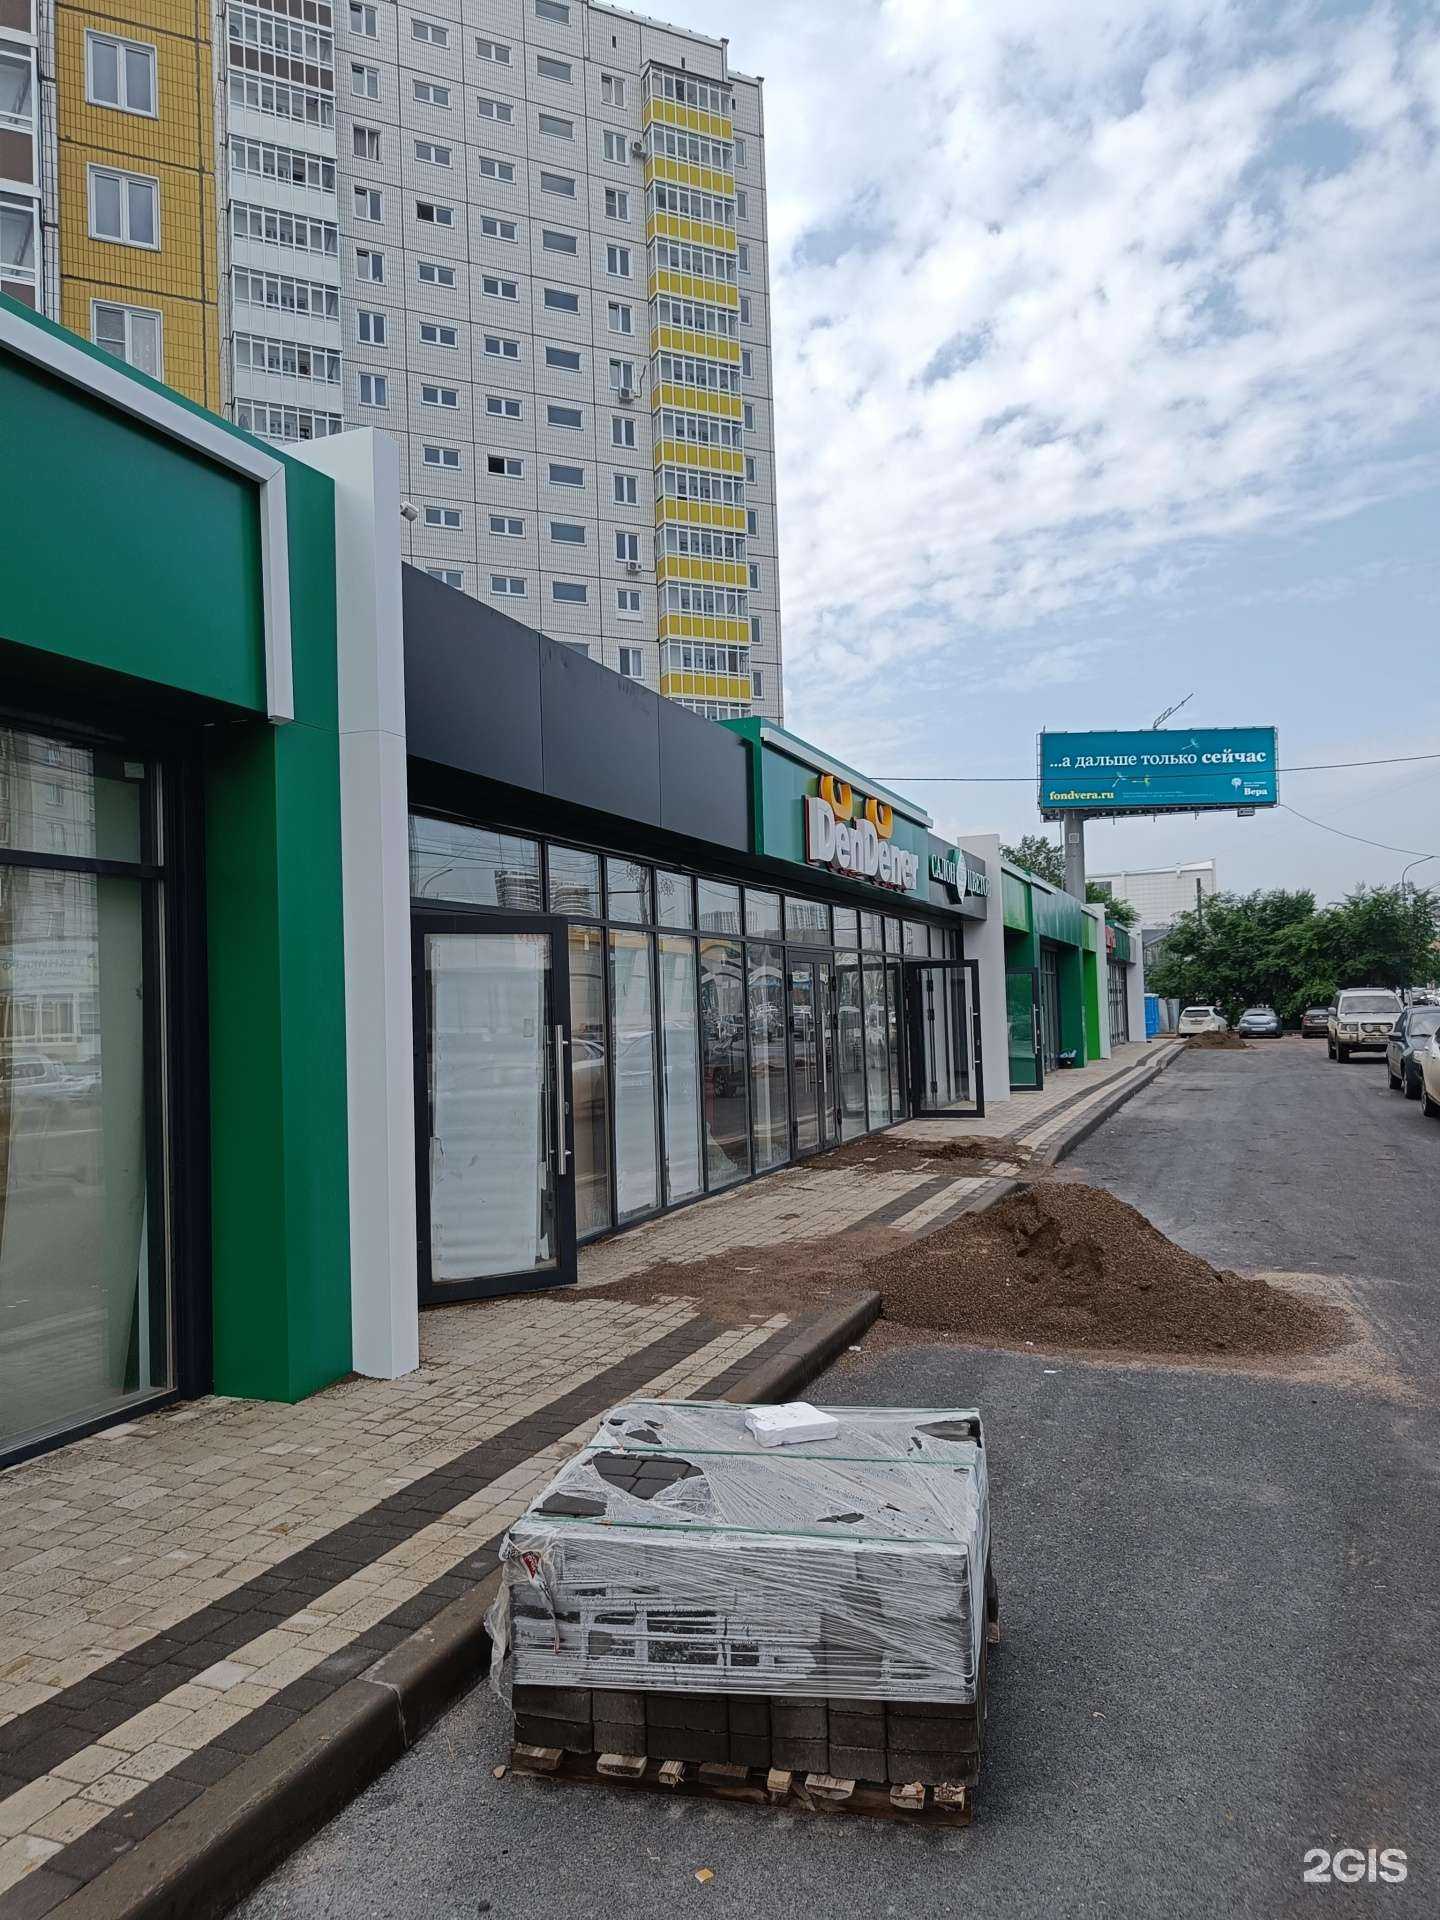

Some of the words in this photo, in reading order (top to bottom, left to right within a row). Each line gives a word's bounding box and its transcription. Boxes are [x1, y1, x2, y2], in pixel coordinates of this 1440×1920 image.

[1075, 755, 1137, 768] дальше
[1140, 753, 1197, 764] только
[1201, 748, 1267, 763] сейчас
[1050, 790, 1114, 800] fondvera.ru
[1244, 787, 1268, 797] Вера
[931, 854, 956, 885] САЛОН
